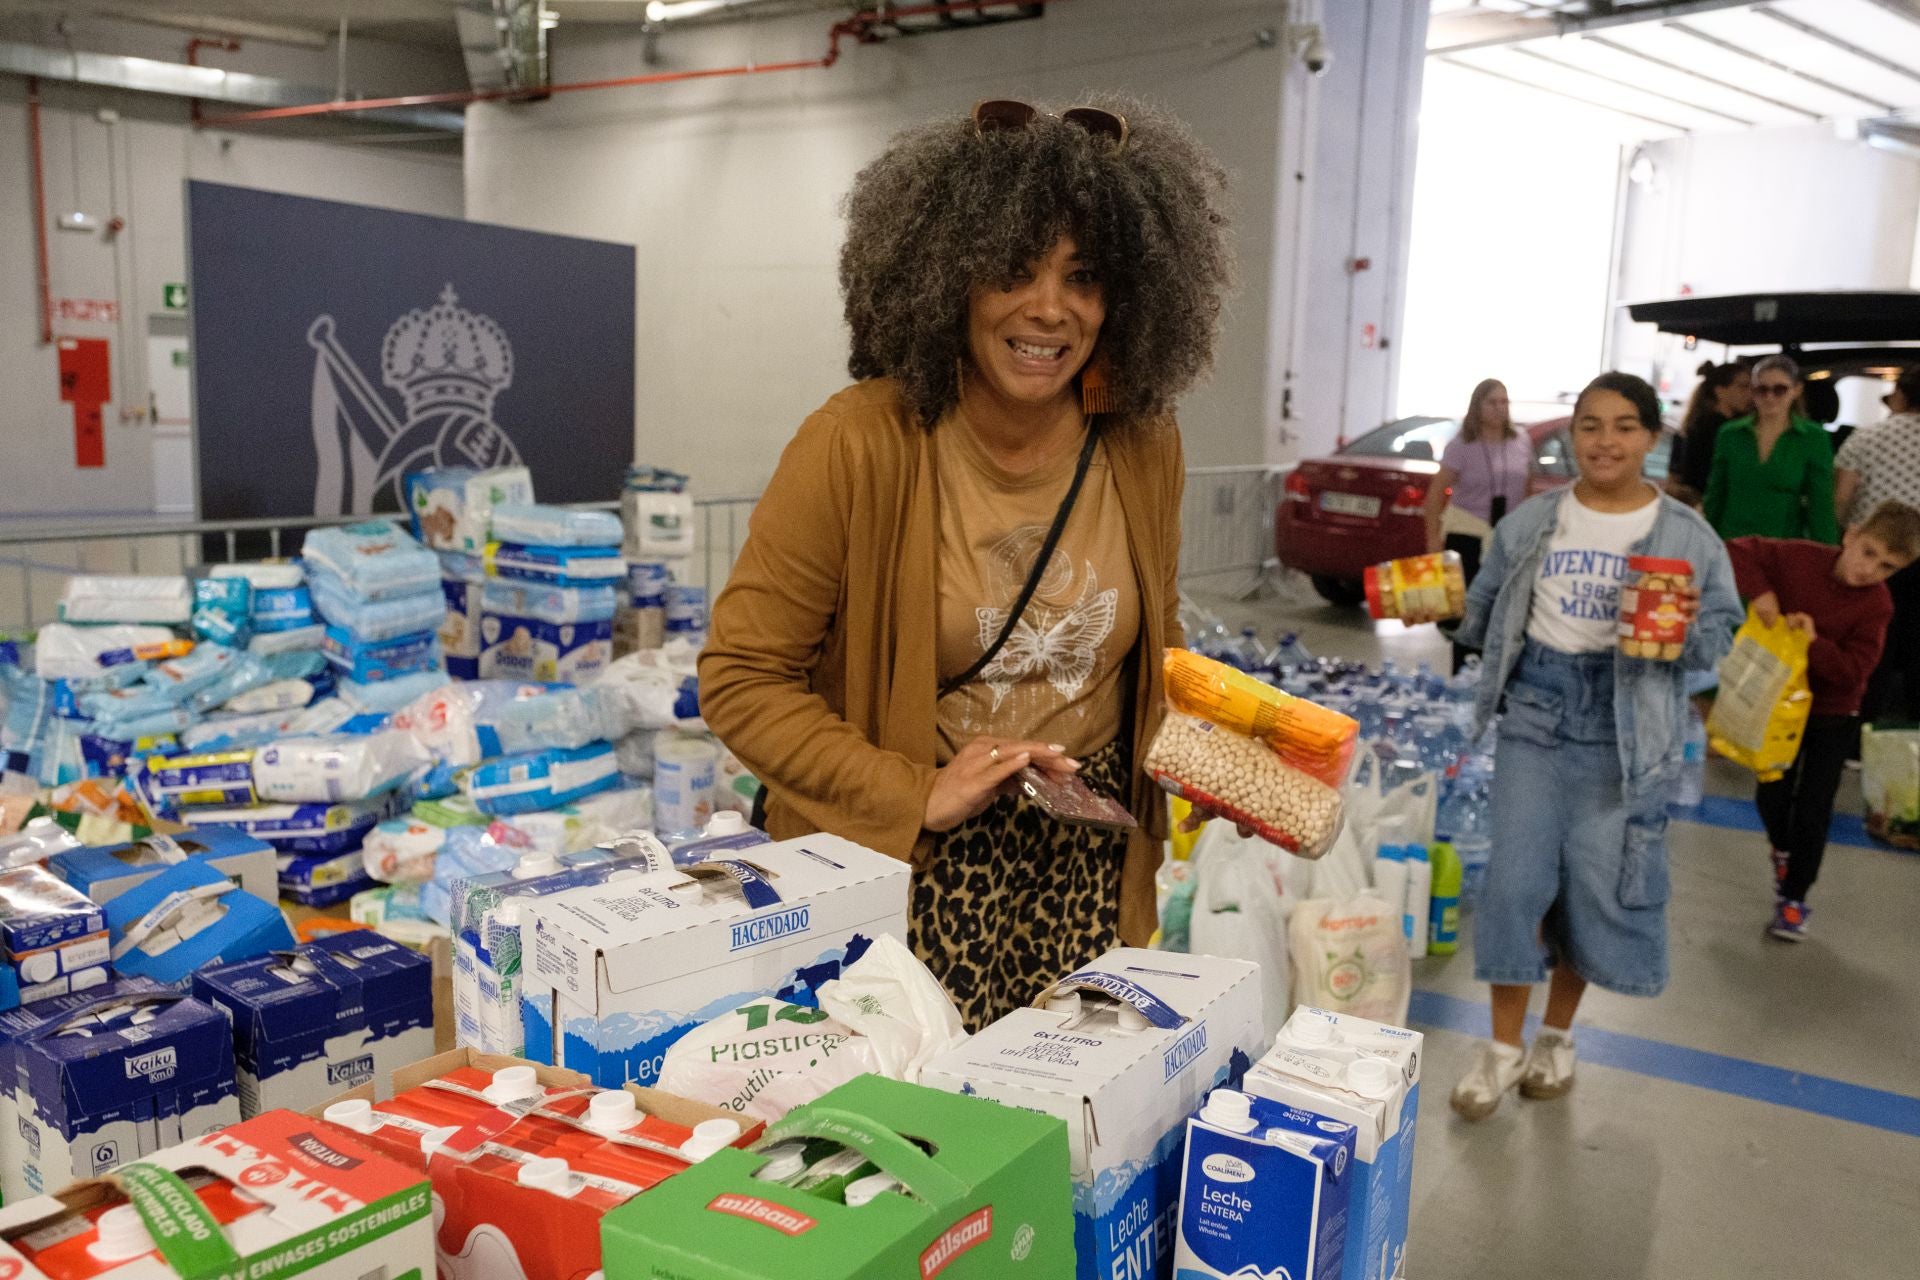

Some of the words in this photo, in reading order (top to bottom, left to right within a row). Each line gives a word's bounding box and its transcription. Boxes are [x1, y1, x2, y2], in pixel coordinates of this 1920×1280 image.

[731, 907, 810, 948] HACENDADO
[336, 1005, 364, 1020] ENTERA
[1022, 1045, 1073, 1059] ENTERA
[1034, 1041, 1078, 1052] LECHE
[1060, 1034, 1103, 1048] LITRO
[1164, 1024, 1208, 1080] HACENDADO
[129, 1053, 172, 1075] Kaiku
[330, 1057, 371, 1082] Kaiku
[1000, 1047, 1028, 1057] UHT
[1045, 1056, 1080, 1067] VACA
[299, 1137, 349, 1168] ENTERA
[1206, 1164, 1247, 1180] COALIMENT
[1202, 1184, 1252, 1212] Leche
[159, 1185, 211, 1241] RECICLADO
[715, 1196, 810, 1232] milsani
[1109, 1197, 1149, 1252] Leche
[1200, 1202, 1244, 1224] ENTERA
[250, 1235, 327, 1280] ENVASES
[327, 1191, 427, 1248] SOSTENIBLES
[923, 1210, 989, 1276] milsani
[1198, 1225, 1218, 1237] Whole
